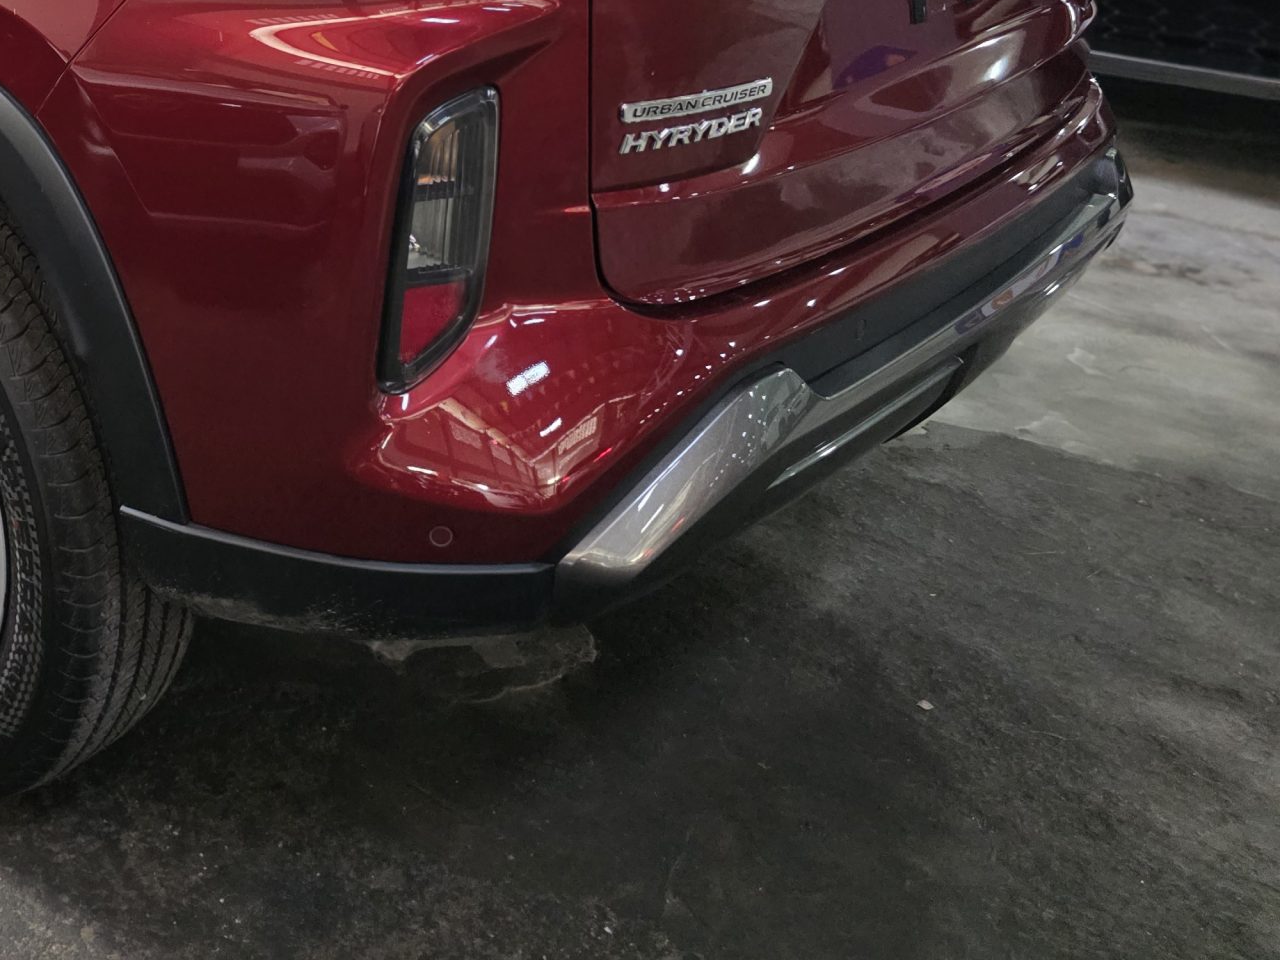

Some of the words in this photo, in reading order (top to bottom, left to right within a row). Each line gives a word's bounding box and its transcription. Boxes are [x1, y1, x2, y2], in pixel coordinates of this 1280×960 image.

[632, 100, 698, 119] URBAN
[702, 85, 767, 107] CRUISER
[620, 107, 762, 154] HYRYDER
